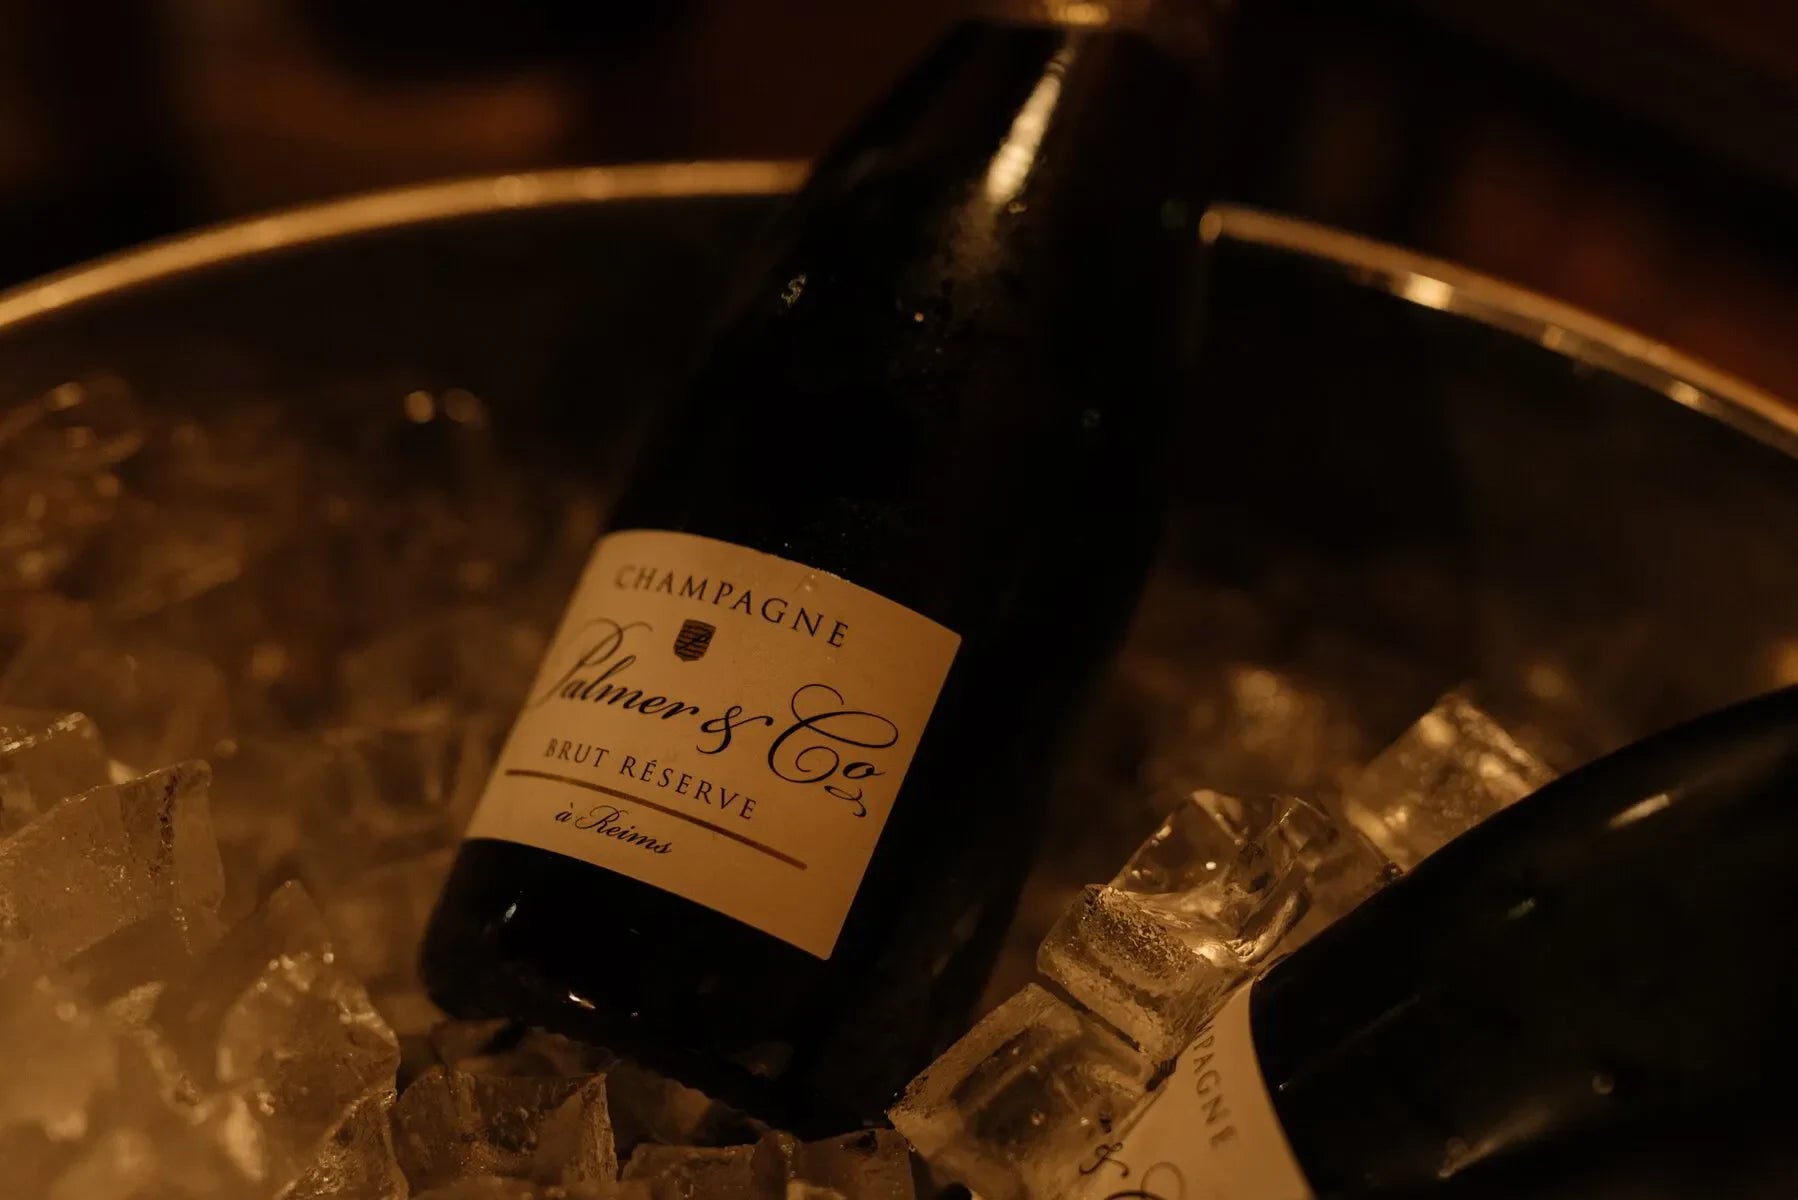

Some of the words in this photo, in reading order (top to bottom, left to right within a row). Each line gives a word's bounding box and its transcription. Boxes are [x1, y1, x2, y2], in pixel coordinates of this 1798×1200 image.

[613, 564, 850, 648] CHAMPAGNE
[533, 617, 699, 719] Palmer
[696, 705, 774, 754] &
[544, 738, 610, 768] BRUT
[620, 758, 757, 820] RÉSERVE
[555, 802, 574, 823] à
[574, 804, 673, 855] Reims
